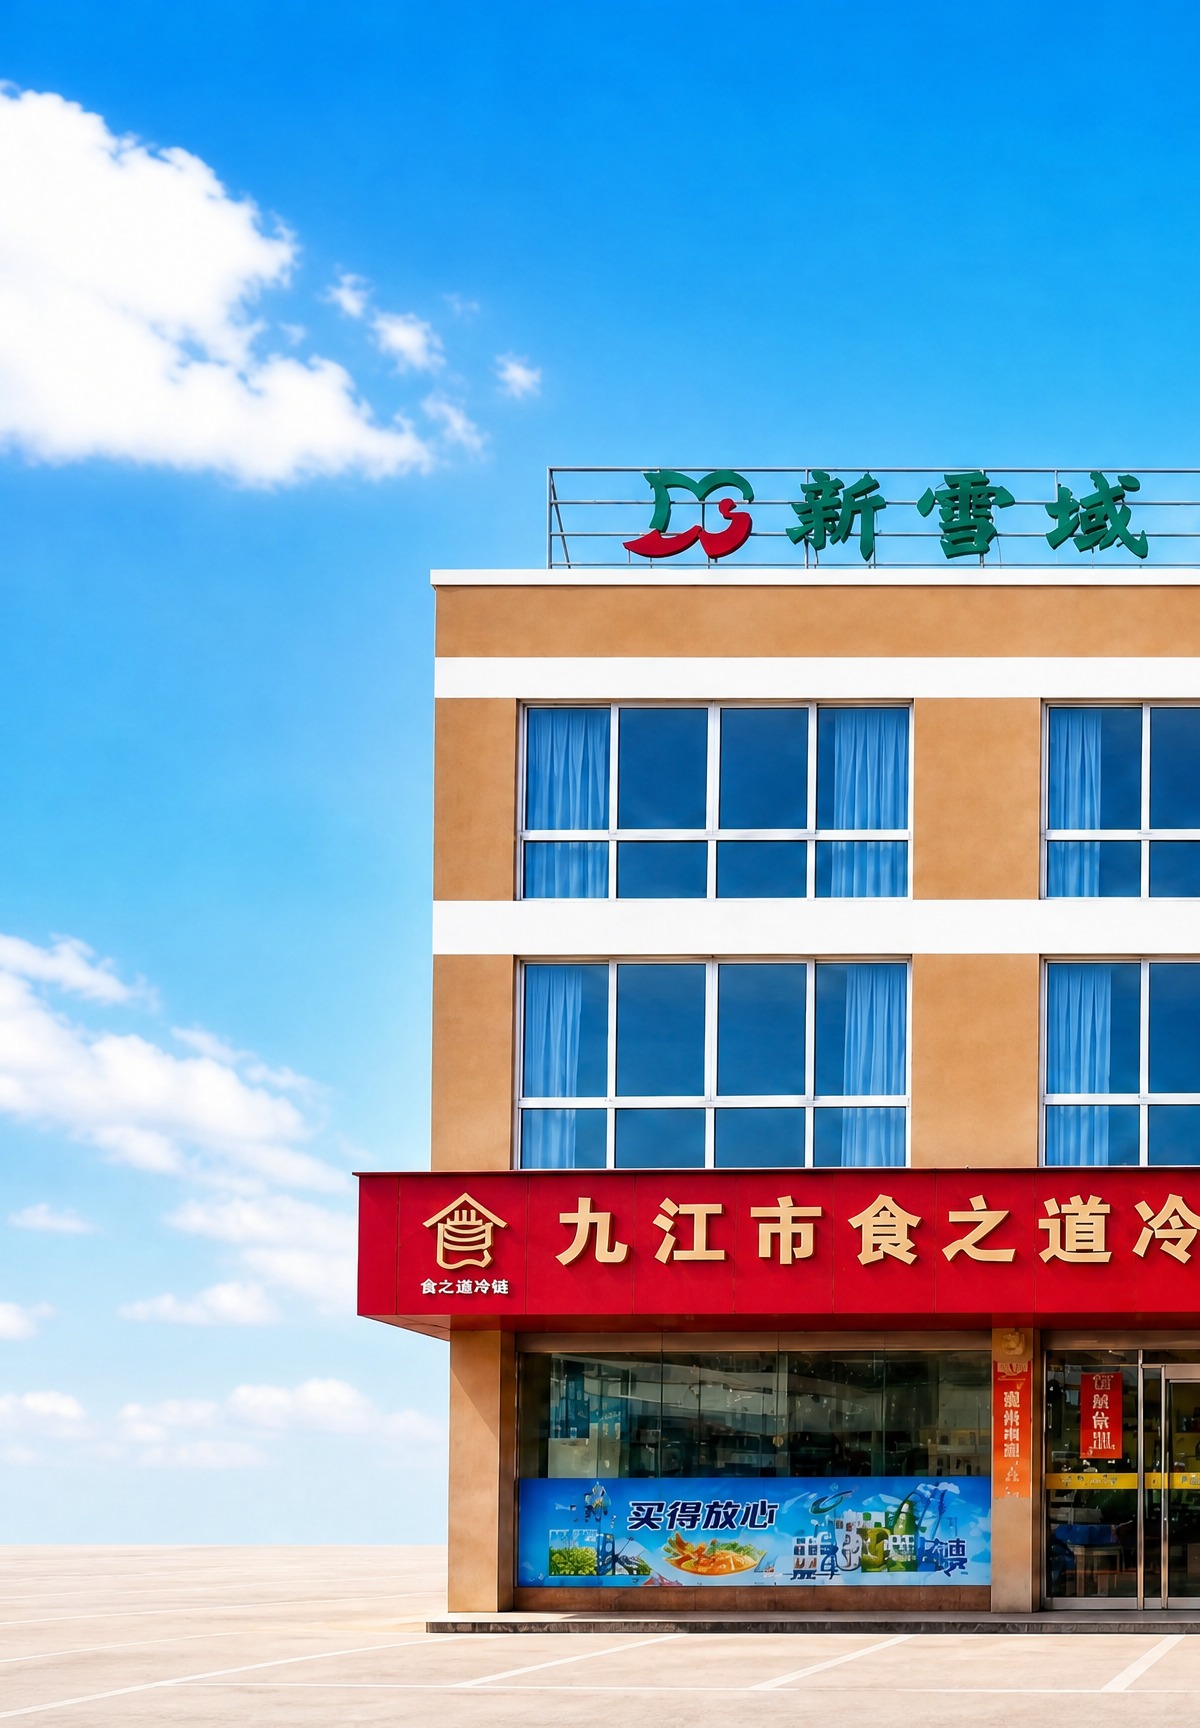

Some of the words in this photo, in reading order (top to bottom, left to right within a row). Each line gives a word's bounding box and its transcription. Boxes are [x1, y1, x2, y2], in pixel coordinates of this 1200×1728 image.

[786, 470, 1148, 562] 新雪域
[626, 1498, 779, 1532] 买得放心
